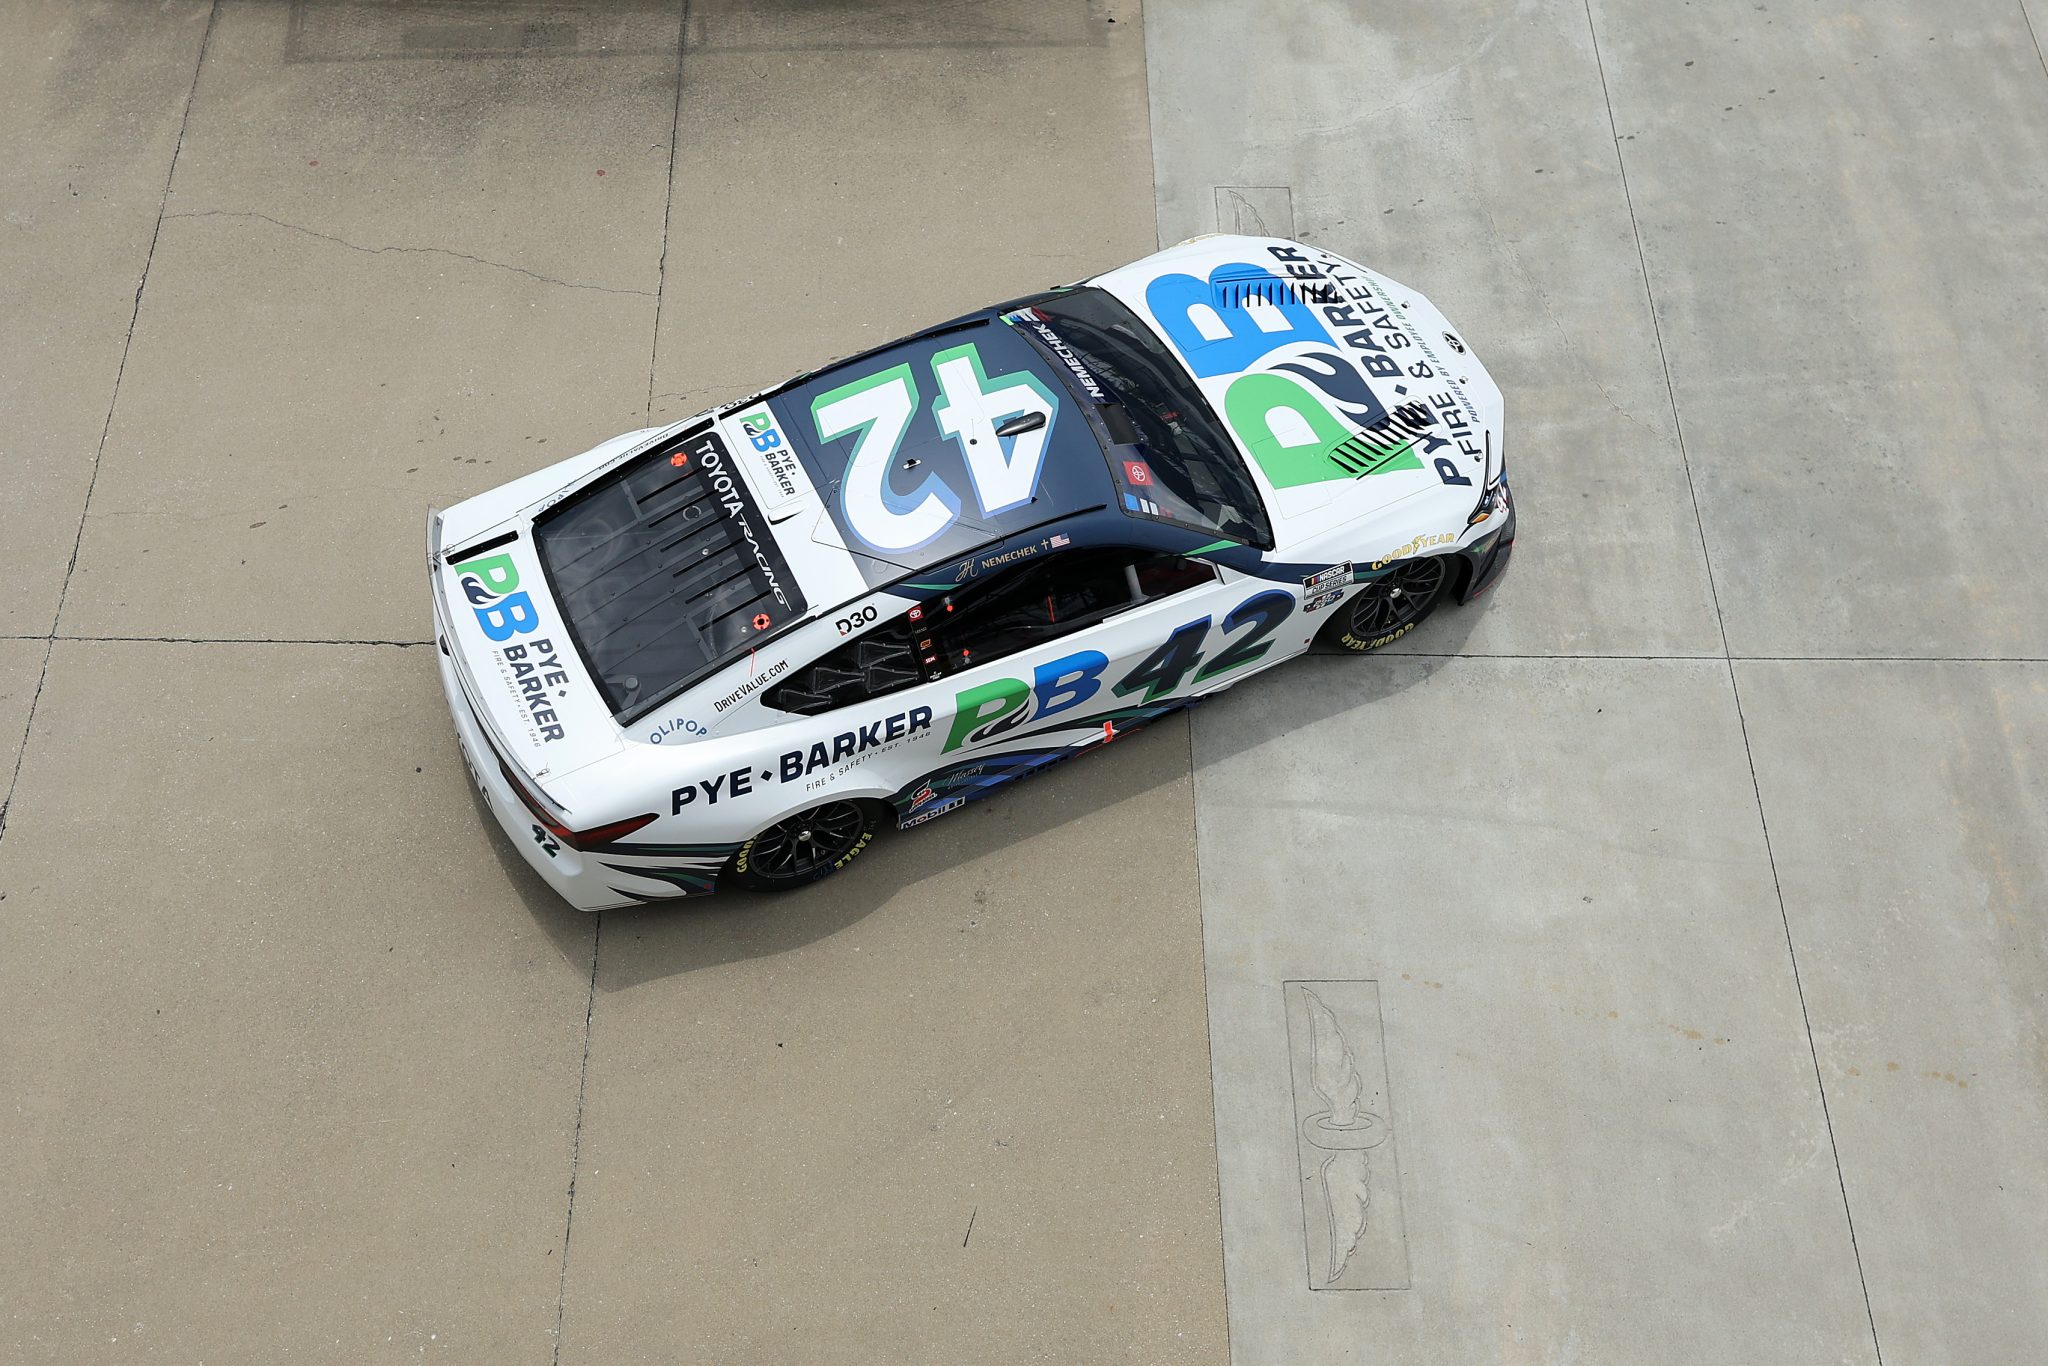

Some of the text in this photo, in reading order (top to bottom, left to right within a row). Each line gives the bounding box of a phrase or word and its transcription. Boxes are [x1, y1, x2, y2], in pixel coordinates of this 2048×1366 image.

[1033, 322, 1104, 398] NEMECHEK
[1317, 260, 1482, 456] FIRE & SAFETY
[1402, 321, 1441, 364] EMPLOYEE
[1267, 247, 1473, 486] PYE BARKER
[1436, 365, 1450, 377] BY
[1446, 379, 1481, 424] POWERED
[776, 449, 796, 471] PYE
[810, 343, 1059, 555] 42
[765, 452, 796, 496] BARKER
[695, 439, 745, 519] TOYOTA
[737, 512, 792, 611] RACING
[981, 545, 1037, 569] NEMECHEK
[1319, 565, 1345, 581] NASCAR
[1371, 532, 1455, 571] GOODYEAR
[1111, 589, 1296, 705] 42
[1341, 622, 1414, 651] GOODYEAR
[492, 650, 504, 666] FIRE
[504, 676, 521, 703] SAFETY
[528, 728, 541, 748] 1946
[503, 638, 569, 743] PYE BARKER
[650, 718, 708, 744] OLIPOP
[671, 705, 933, 816] PYE BARKER
[806, 777, 826, 792] FIRE
[829, 773, 835, 781] &
[838, 752, 873, 776] SAFETY
[907, 731, 931, 743] 1946
[901, 805, 947, 829] Mobil
[532, 824, 560, 858] 42
[834, 832, 873, 870] EAGLE
